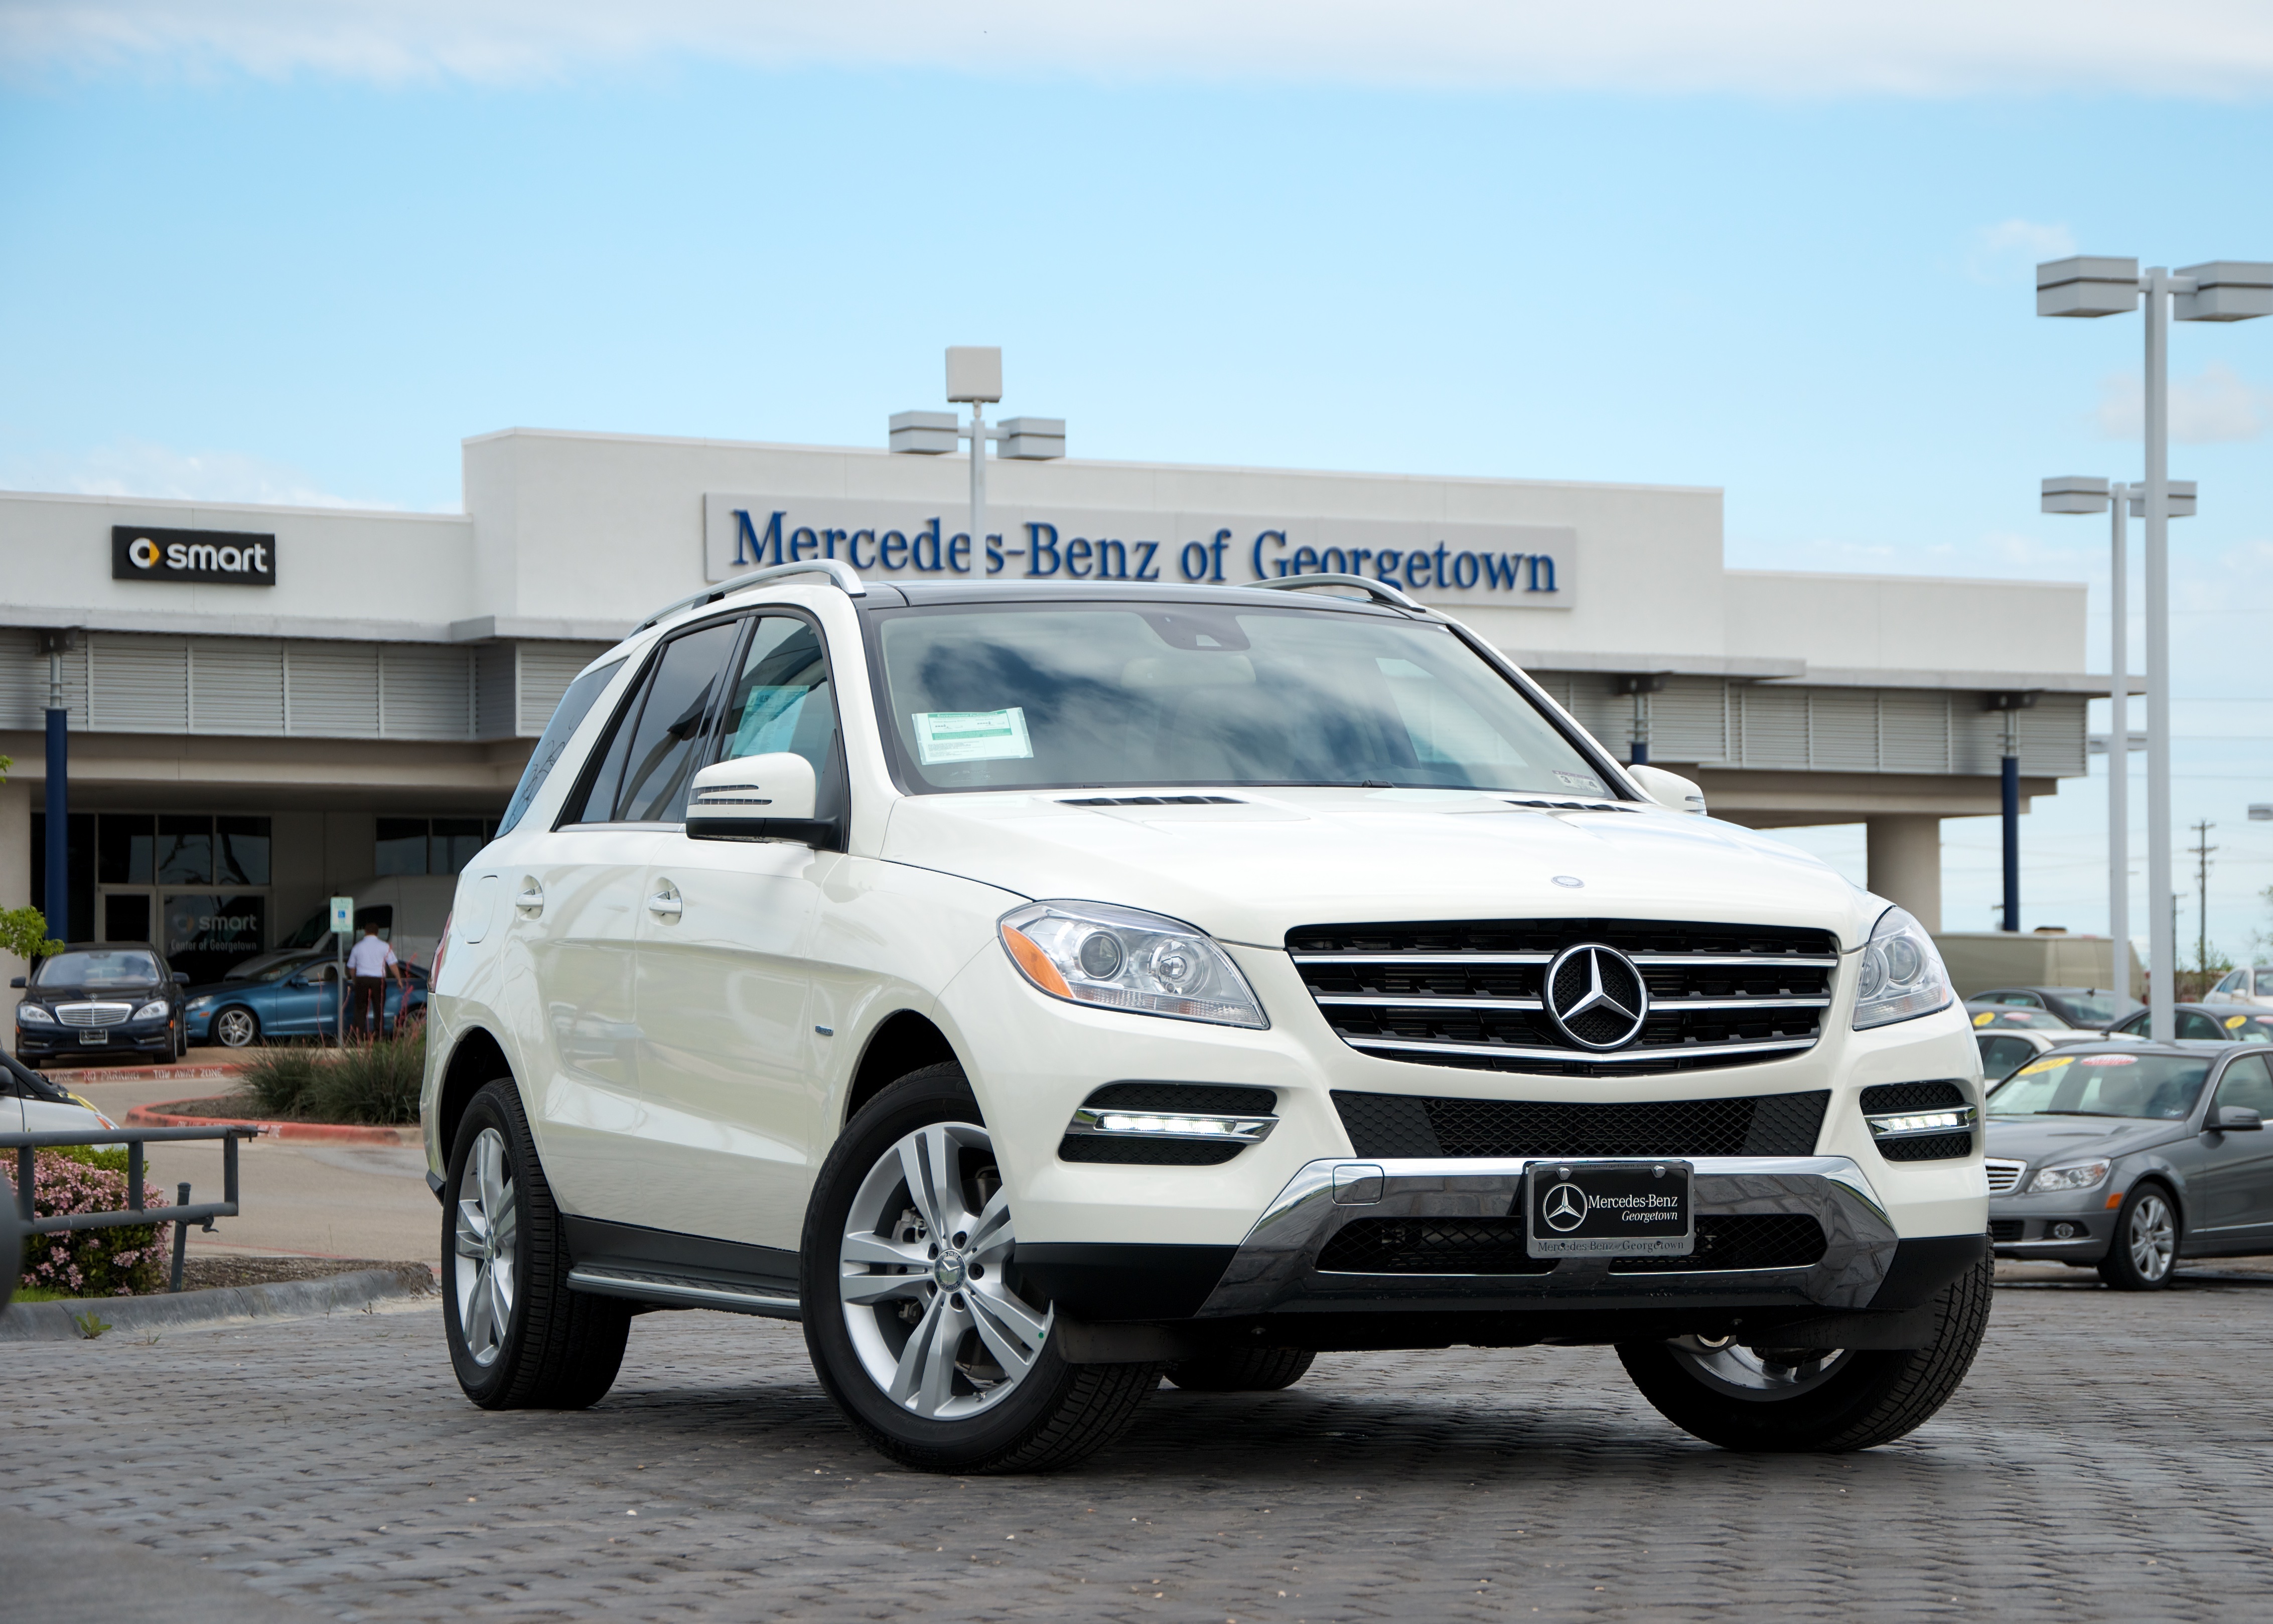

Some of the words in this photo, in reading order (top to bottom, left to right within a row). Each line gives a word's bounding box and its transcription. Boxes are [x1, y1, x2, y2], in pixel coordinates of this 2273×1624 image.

[166, 543, 268, 573] smart
[732, 509, 1160, 580] Mercedes-Benz
[1181, 528, 1231, 581] of
[1253, 529, 1558, 593] Georgetown
[199, 914, 256, 931] smart
[171, 939, 196, 951] Center
[199, 938, 207, 951] of
[210, 939, 256, 953] Georgetown
[83, 1071, 96, 1081] NO
[101, 1070, 139, 1081] PARKING
[153, 1069, 170, 1079] TOW
[175, 1068, 195, 1078] AWAY
[200, 1067, 223, 1078] ZONE
[1588, 1194, 1677, 1208] Mercedes-Benz
[1622, 1210, 1678, 1223] Georgetown
[1537, 1242, 1614, 1252] Mercedes-Benz
